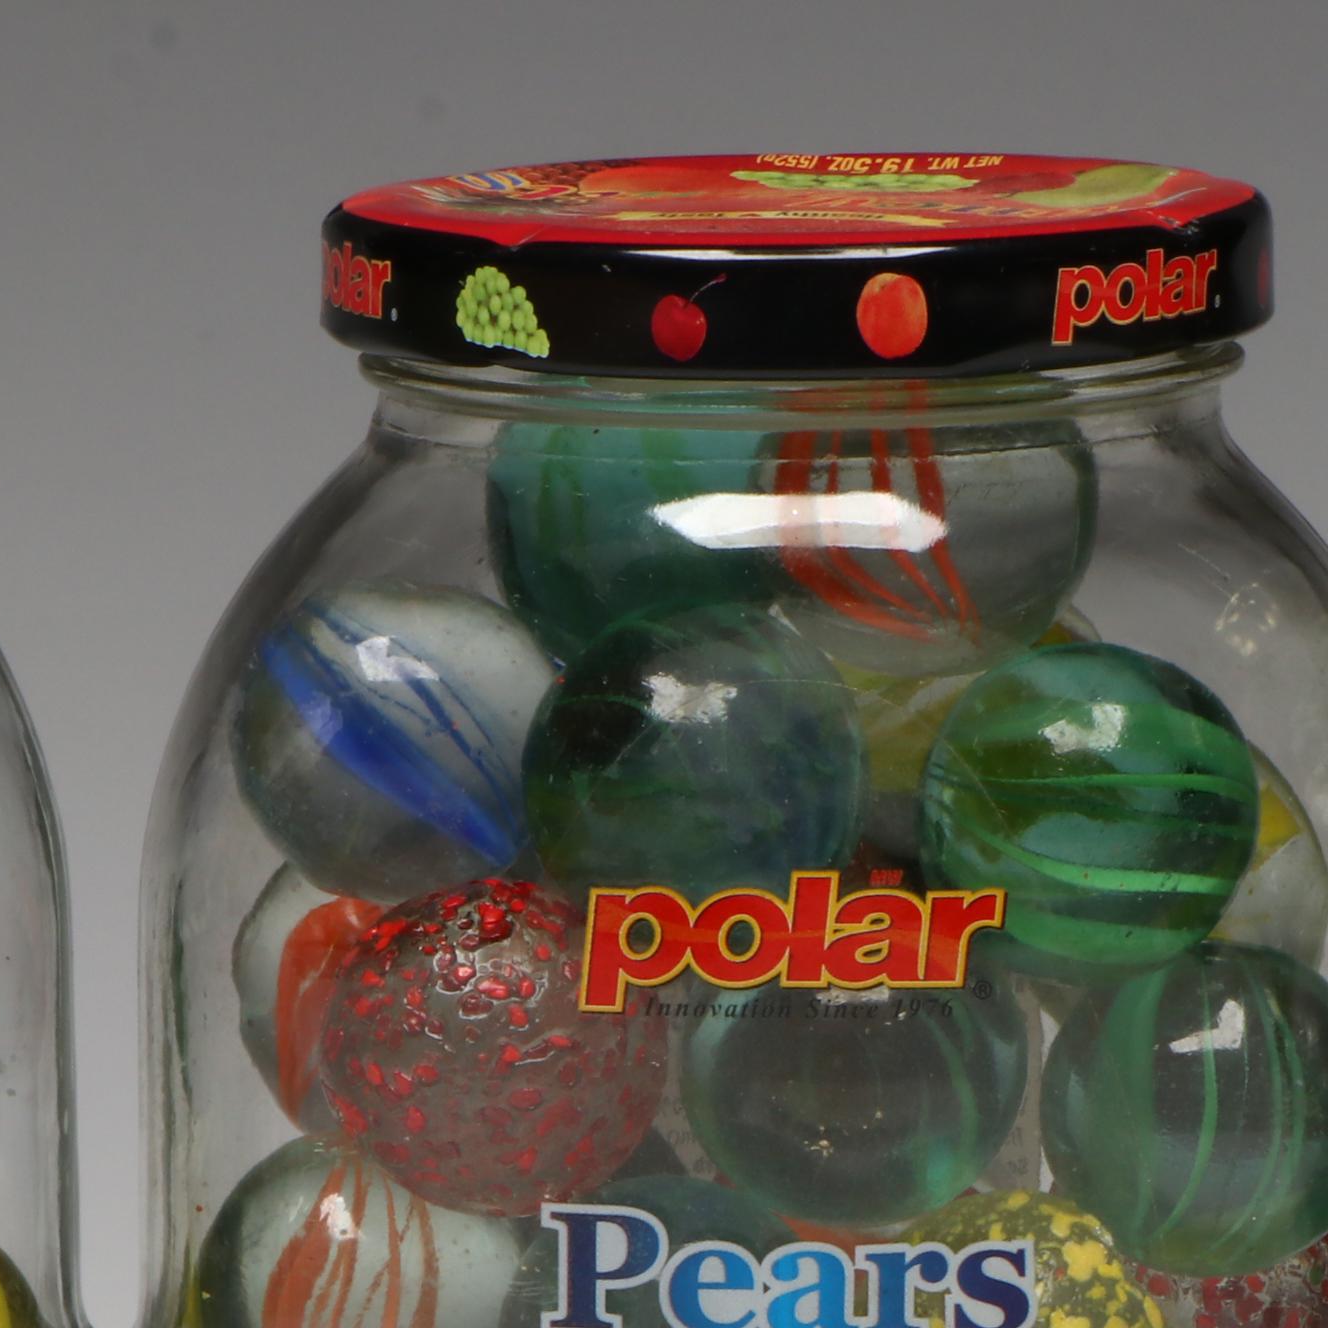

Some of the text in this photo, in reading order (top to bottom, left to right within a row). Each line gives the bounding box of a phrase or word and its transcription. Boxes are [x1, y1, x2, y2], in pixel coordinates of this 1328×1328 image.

[927, 155, 960, 170] WT.
[963, 155, 1004, 169] NET
[1051, 248, 1217, 347] polar
[578, 870, 1008, 1014] polar
[645, 998, 954, 1019] Innovation Since 1976
